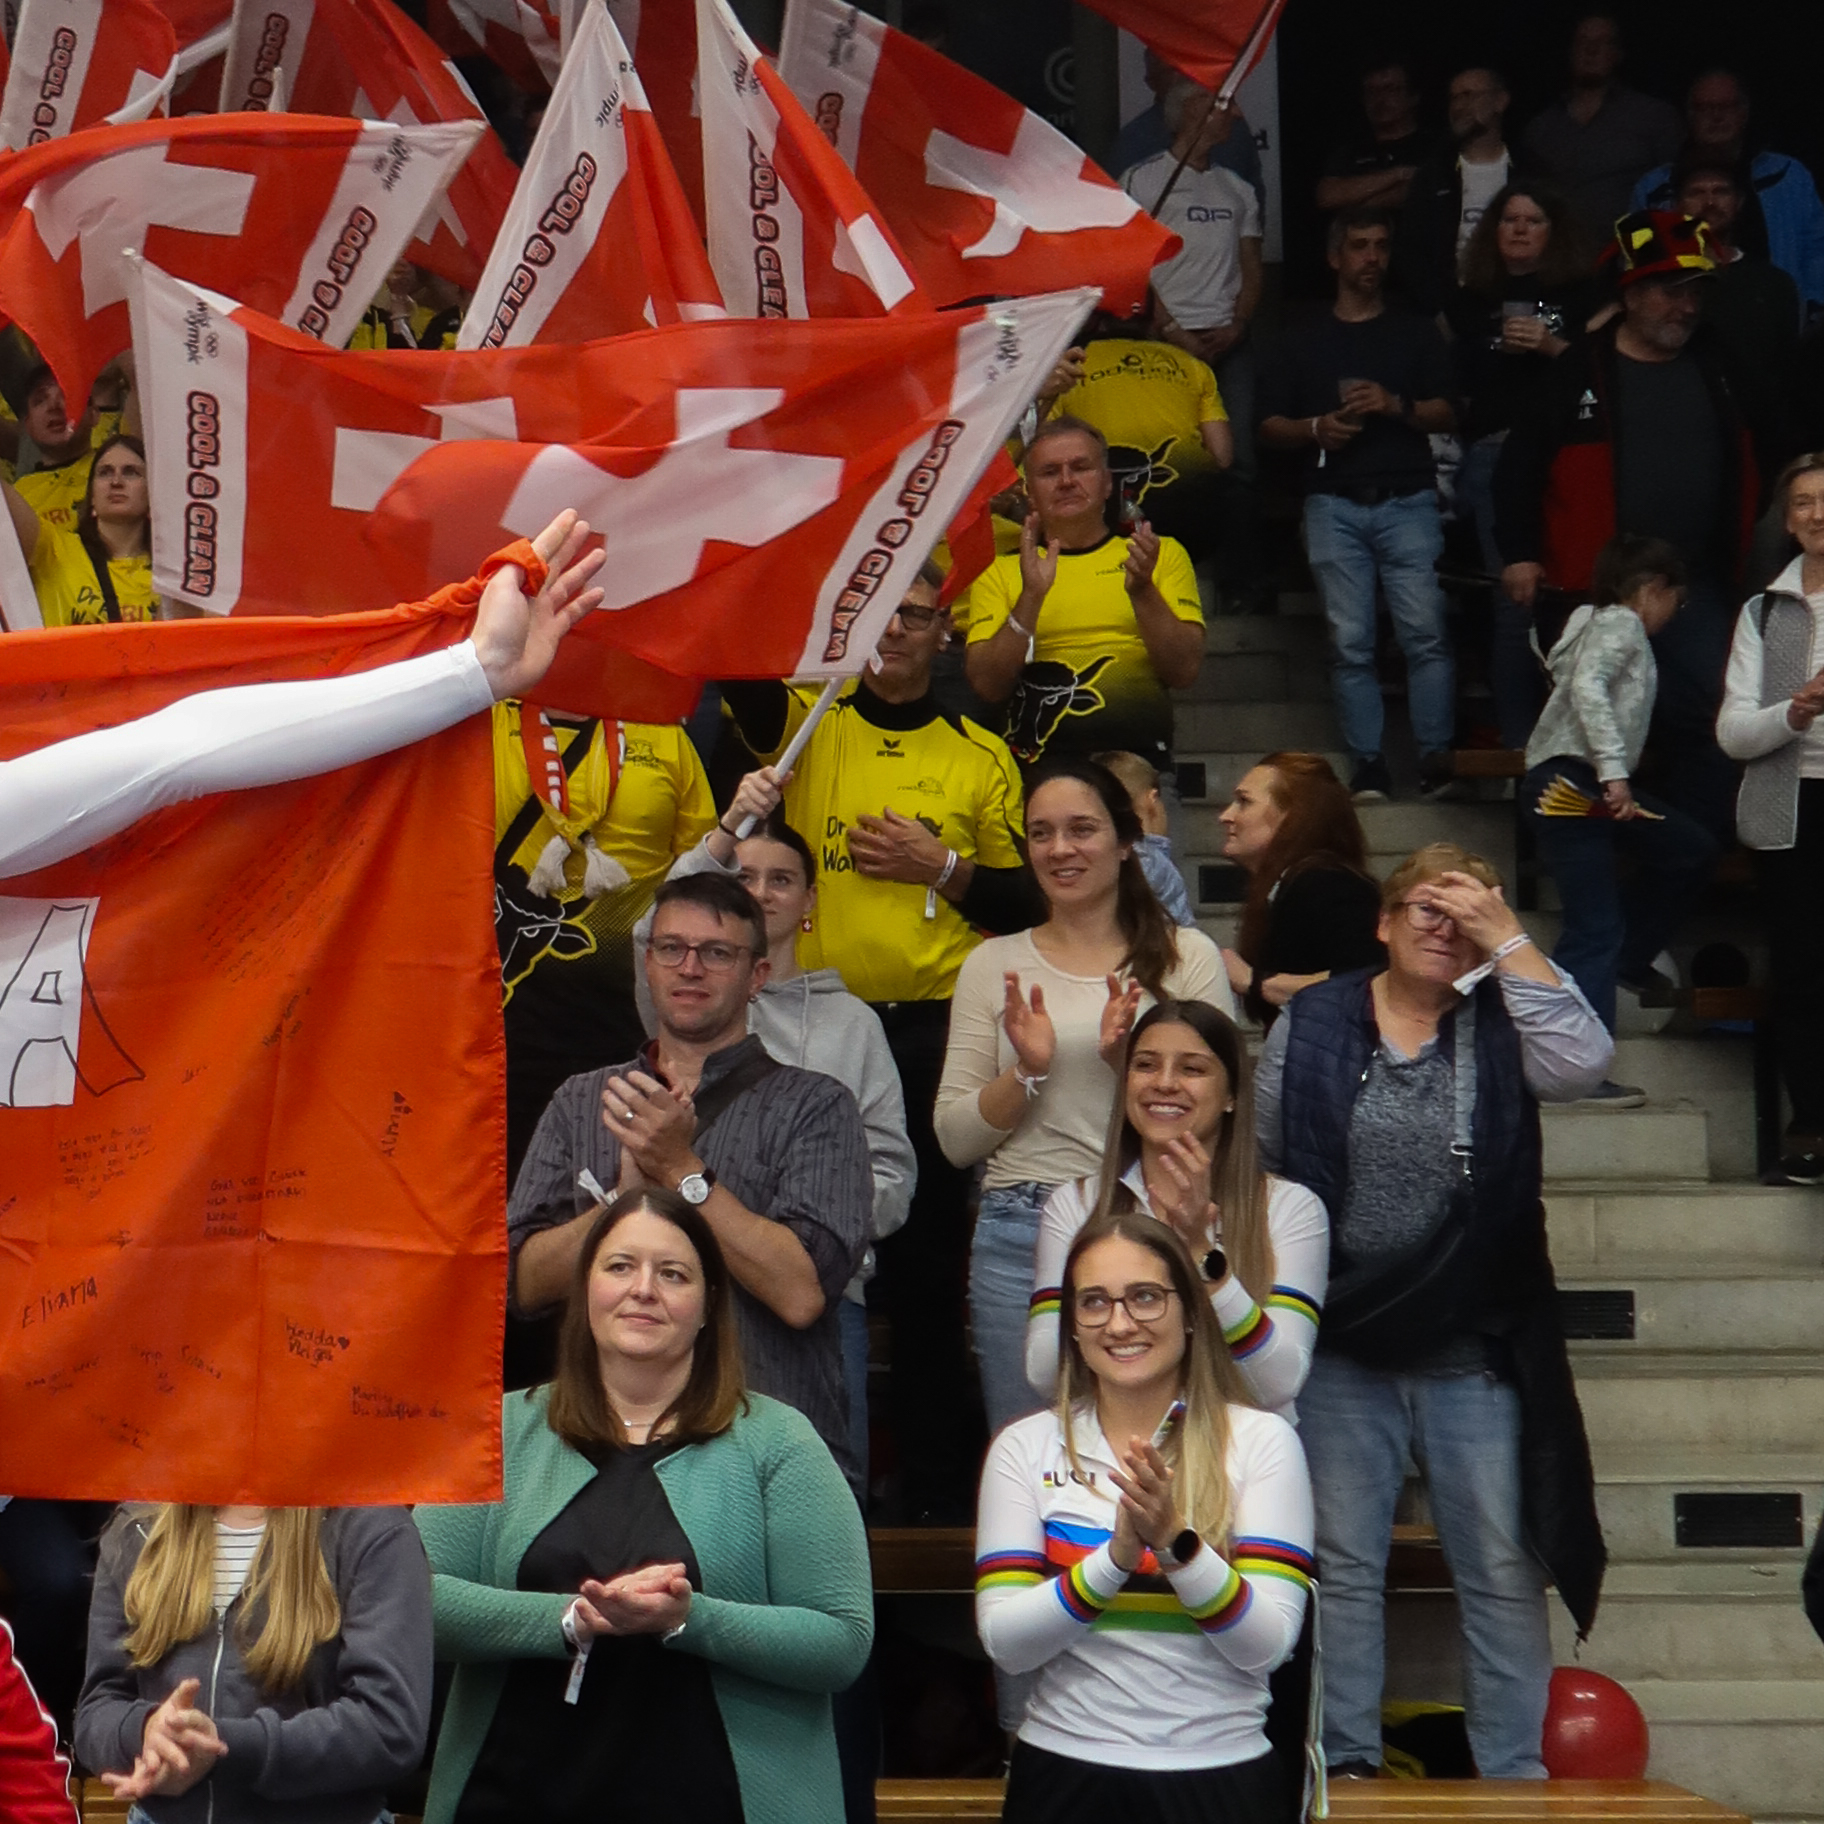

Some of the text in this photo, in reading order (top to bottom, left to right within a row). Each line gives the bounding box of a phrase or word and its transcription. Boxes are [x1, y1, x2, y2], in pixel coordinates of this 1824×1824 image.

[40, 27, 77, 102] COOL
[539, 150, 597, 235] COOL
[480, 263, 535, 349] CLEA
[181, 390, 220, 597] COOL & CLEAN
